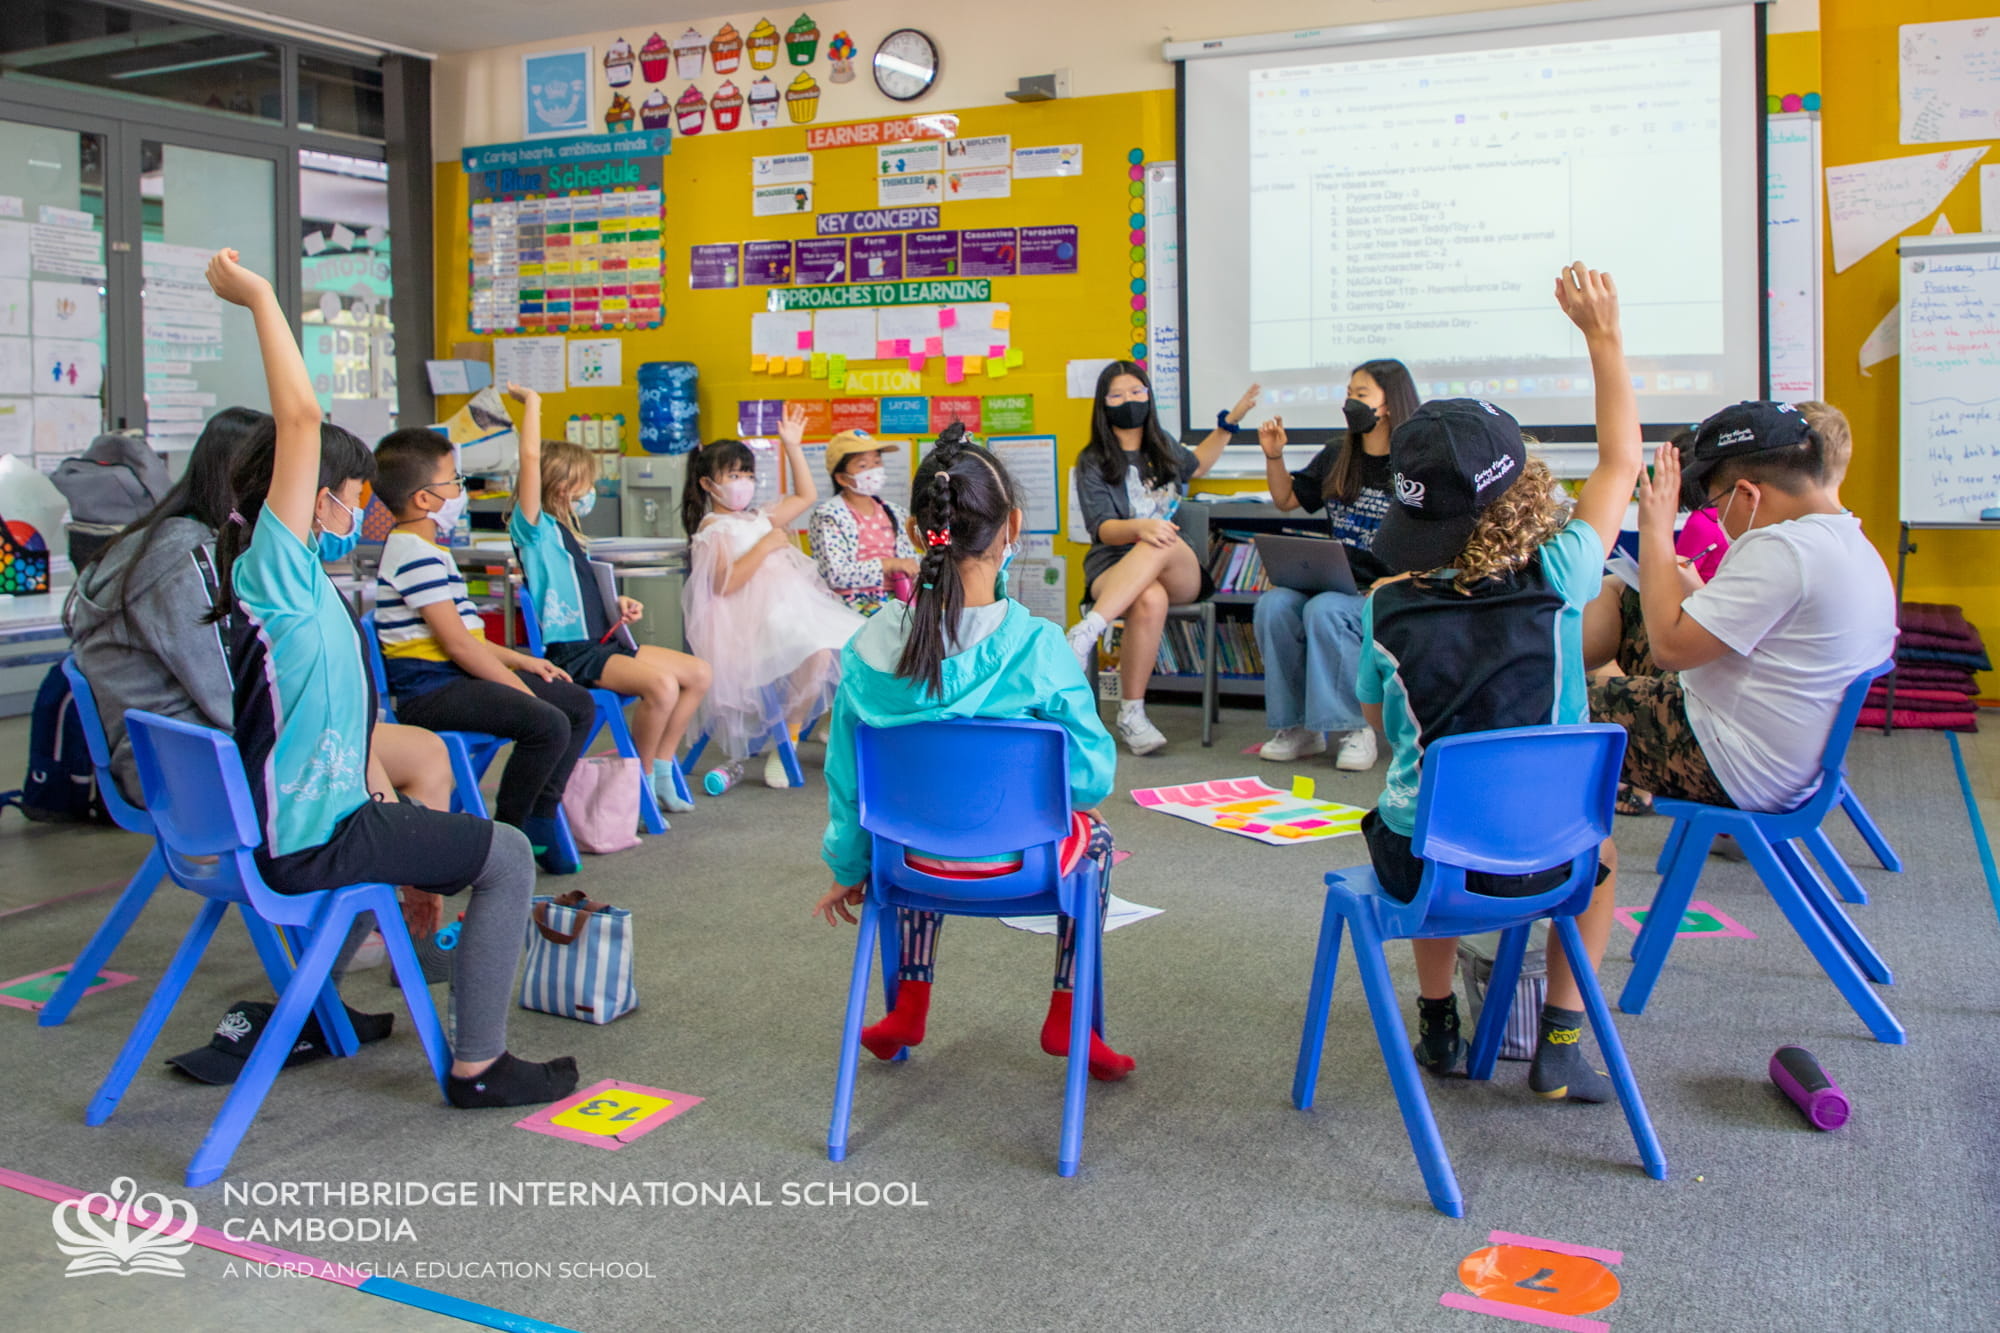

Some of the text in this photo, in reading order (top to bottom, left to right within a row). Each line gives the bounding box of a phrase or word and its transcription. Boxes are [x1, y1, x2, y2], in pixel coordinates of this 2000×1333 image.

[755, 38, 774, 48] May
[793, 33, 814, 43] June
[717, 42, 738, 52] April
[788, 90, 820, 100] December
[714, 98, 742, 109] October
[643, 106, 670, 118] August
[807, 123, 879, 148] LEARNER
[966, 136, 1007, 147] REFLECTIVE
[484, 150, 517, 165] Caring
[559, 141, 611, 157] ambitious
[614, 137, 647, 151] minds
[484, 160, 640, 192] 4 Blue Schedule
[882, 176, 925, 187] THINKERS
[1346, 191, 1381, 204] Pyjama
[1384, 190, 1403, 202] Day
[1346, 203, 1419, 214] Monochromatic
[1422, 200, 1442, 211] Day
[818, 207, 939, 233] KEY CONCEPTS
[1346, 215, 1370, 226] Back
[1373, 215, 1382, 224] in
[1385, 213, 1408, 223] Time
[1410, 211, 1430, 223] Day
[916, 233, 947, 242] Change
[965, 230, 1014, 240] Connection
[1022, 227, 1075, 237] Perspective
[1346, 227, 1372, 240] Bring
[1374, 226, 1396, 236] Your
[864, 237, 886, 245] Form
[1346, 239, 1374, 251] Lunar
[1377, 239, 1399, 249] New
[1401, 237, 1423, 247] Year
[1425, 236, 1445, 248] Day
[1498, 232, 1520, 244] your
[1441, 246, 1449, 257] 2
[1425, 259, 1445, 271] Day
[1384, 274, 1405, 286] Day
[873, 284, 895, 302] TO
[901, 280, 989, 301] LEARNING
[1346, 287, 1396, 299] November
[1427, 280, 1499, 294] Remembrance
[1501, 279, 1521, 292] Day
[1346, 300, 1385, 313] Gaming
[1386, 298, 1406, 310] Day
[1346, 320, 1384, 333] Change
[1386, 319, 1402, 330] the
[1404, 317, 1450, 329] Schedule
[1452, 315, 1472, 329] Day
[1346, 333, 1366, 345] Fun
[1367, 332, 1387, 345] Day
[847, 371, 921, 392] ACTION
[833, 403, 876, 415] THINKING
[889, 400, 921, 412] SAYING
[939, 400, 971, 412] DOING
[988, 398, 1025, 410] HAVING
[1475, 454, 1511, 483] Caring Hearts
[577, 1099, 640, 1122] 13
[1514, 1267, 1560, 1293] 7
